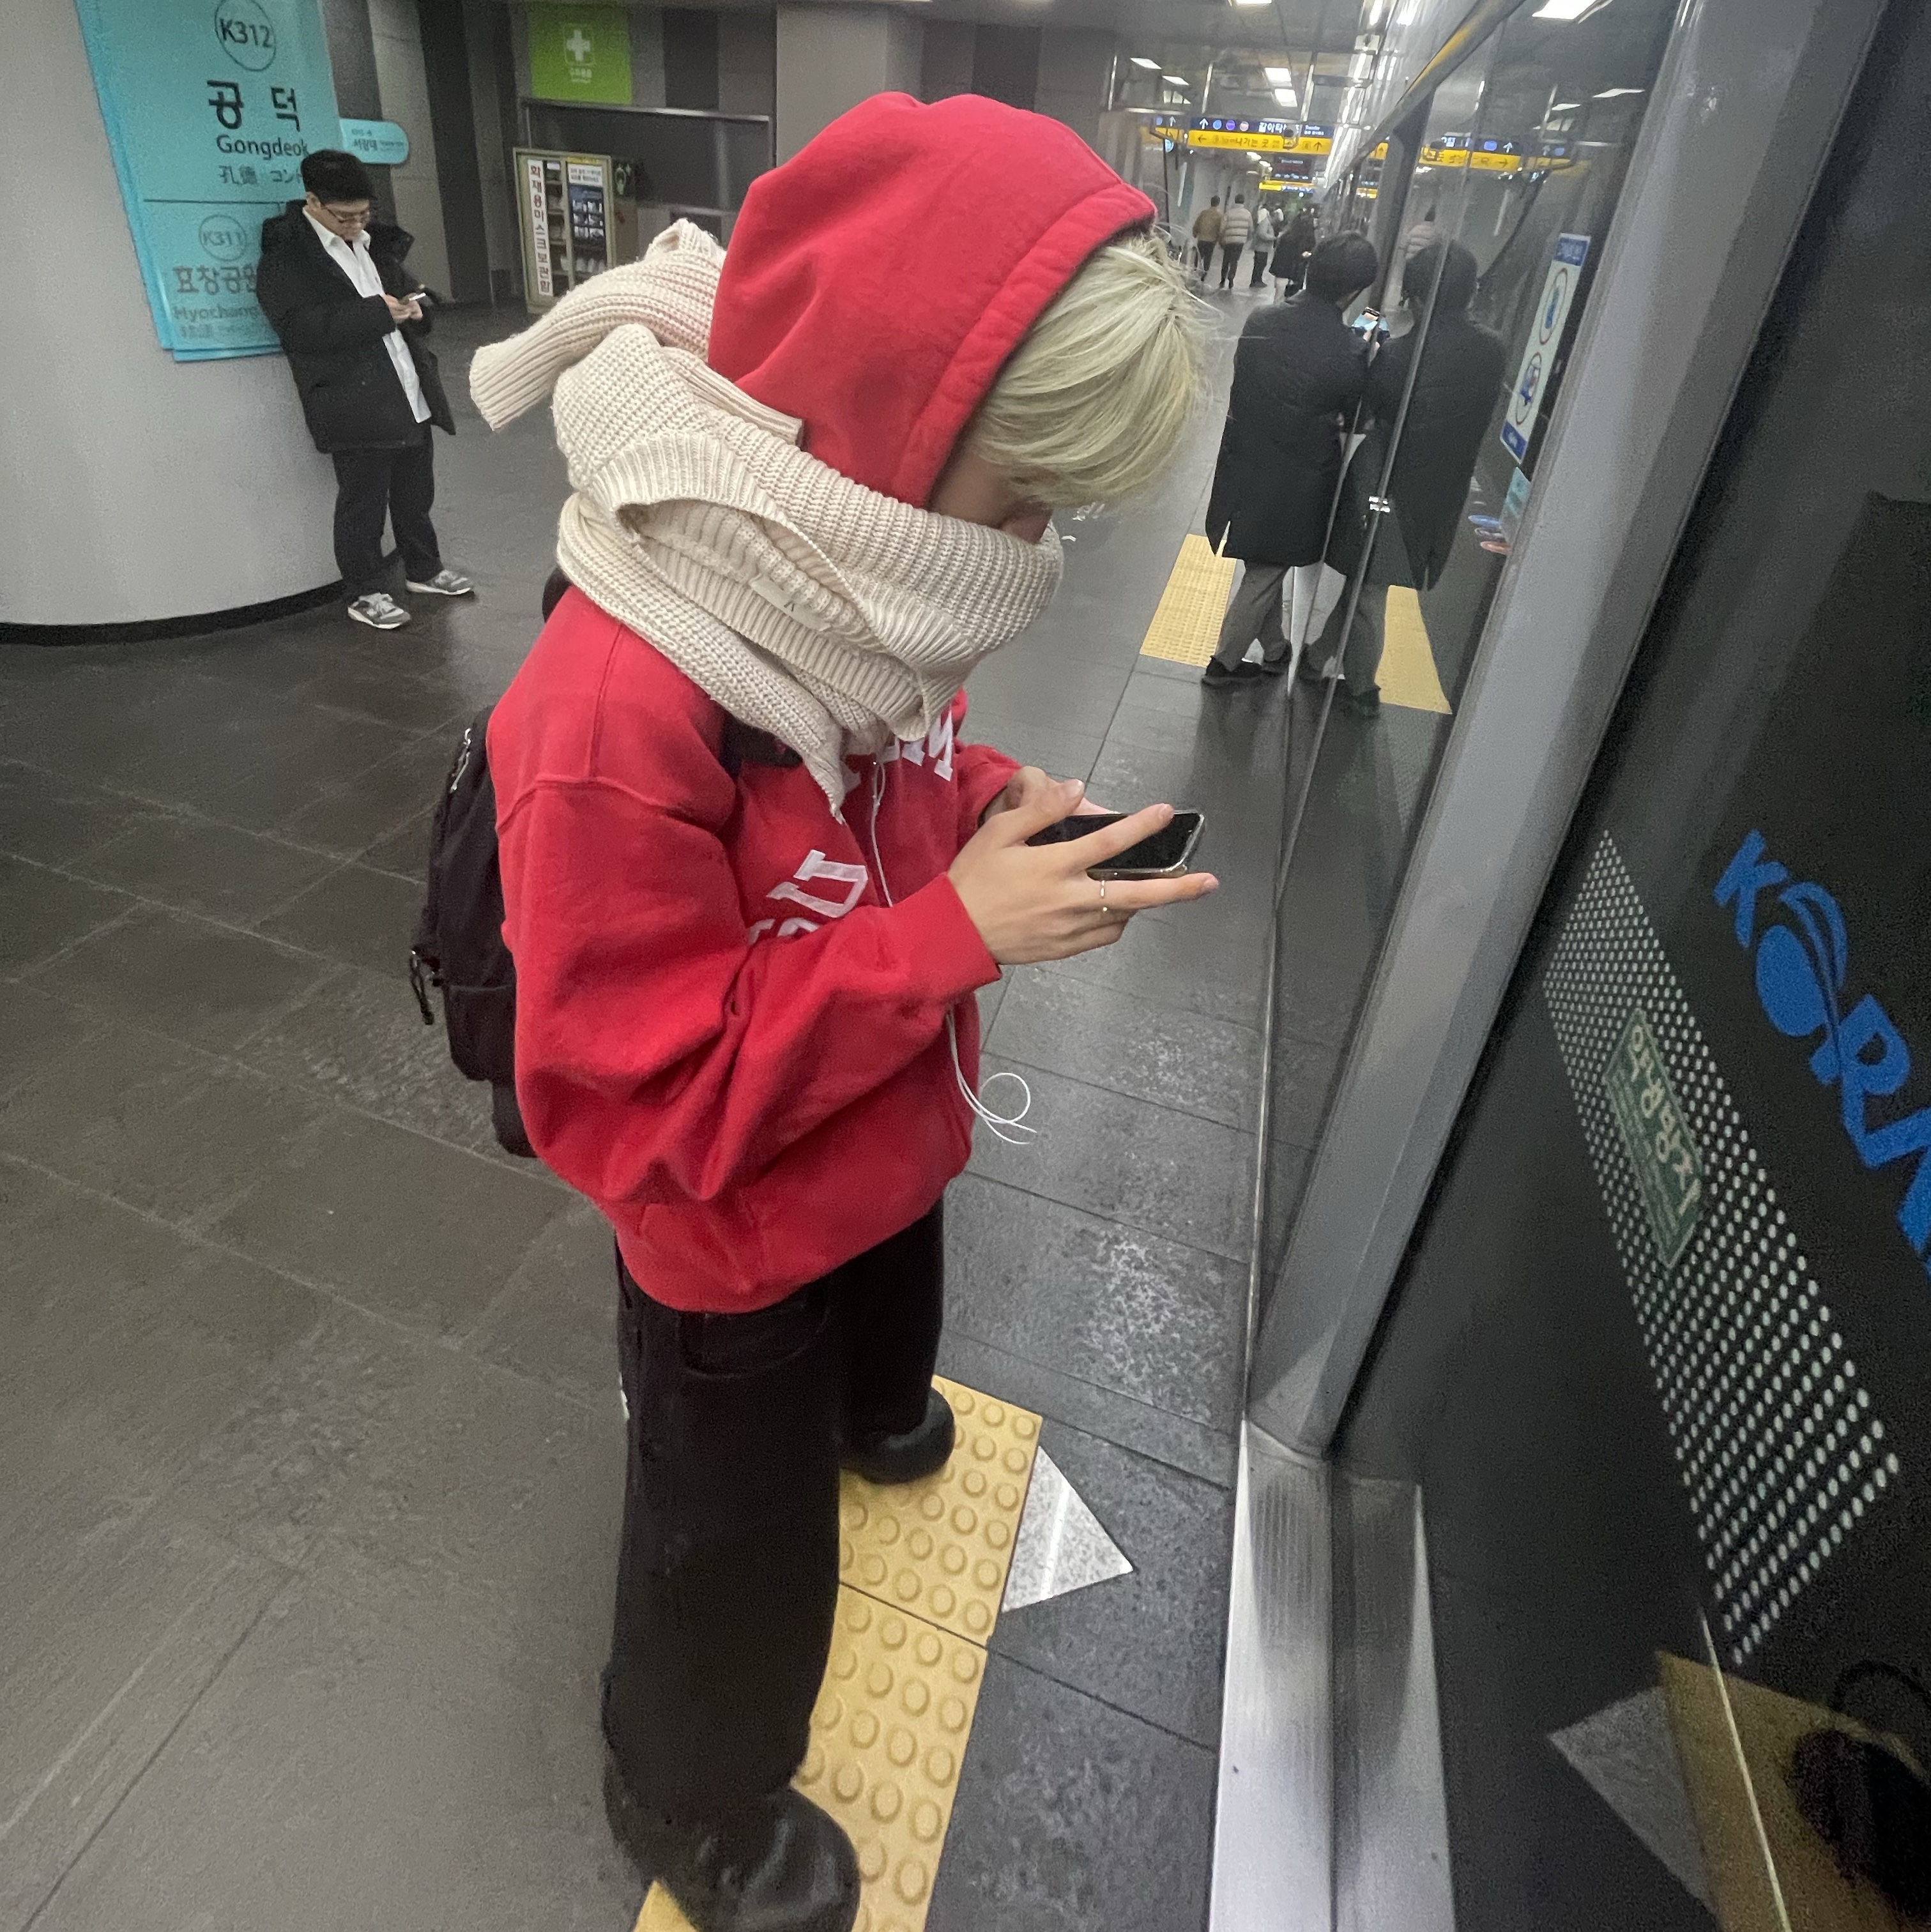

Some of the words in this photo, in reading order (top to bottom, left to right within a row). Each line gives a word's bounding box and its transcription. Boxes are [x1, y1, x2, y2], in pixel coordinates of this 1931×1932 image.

[219, 18, 272, 49] K312
[216, 133, 310, 160] Gongdeok
[203, 231, 243, 247] K311
[1713, 828, 1931, 1281] KORA
